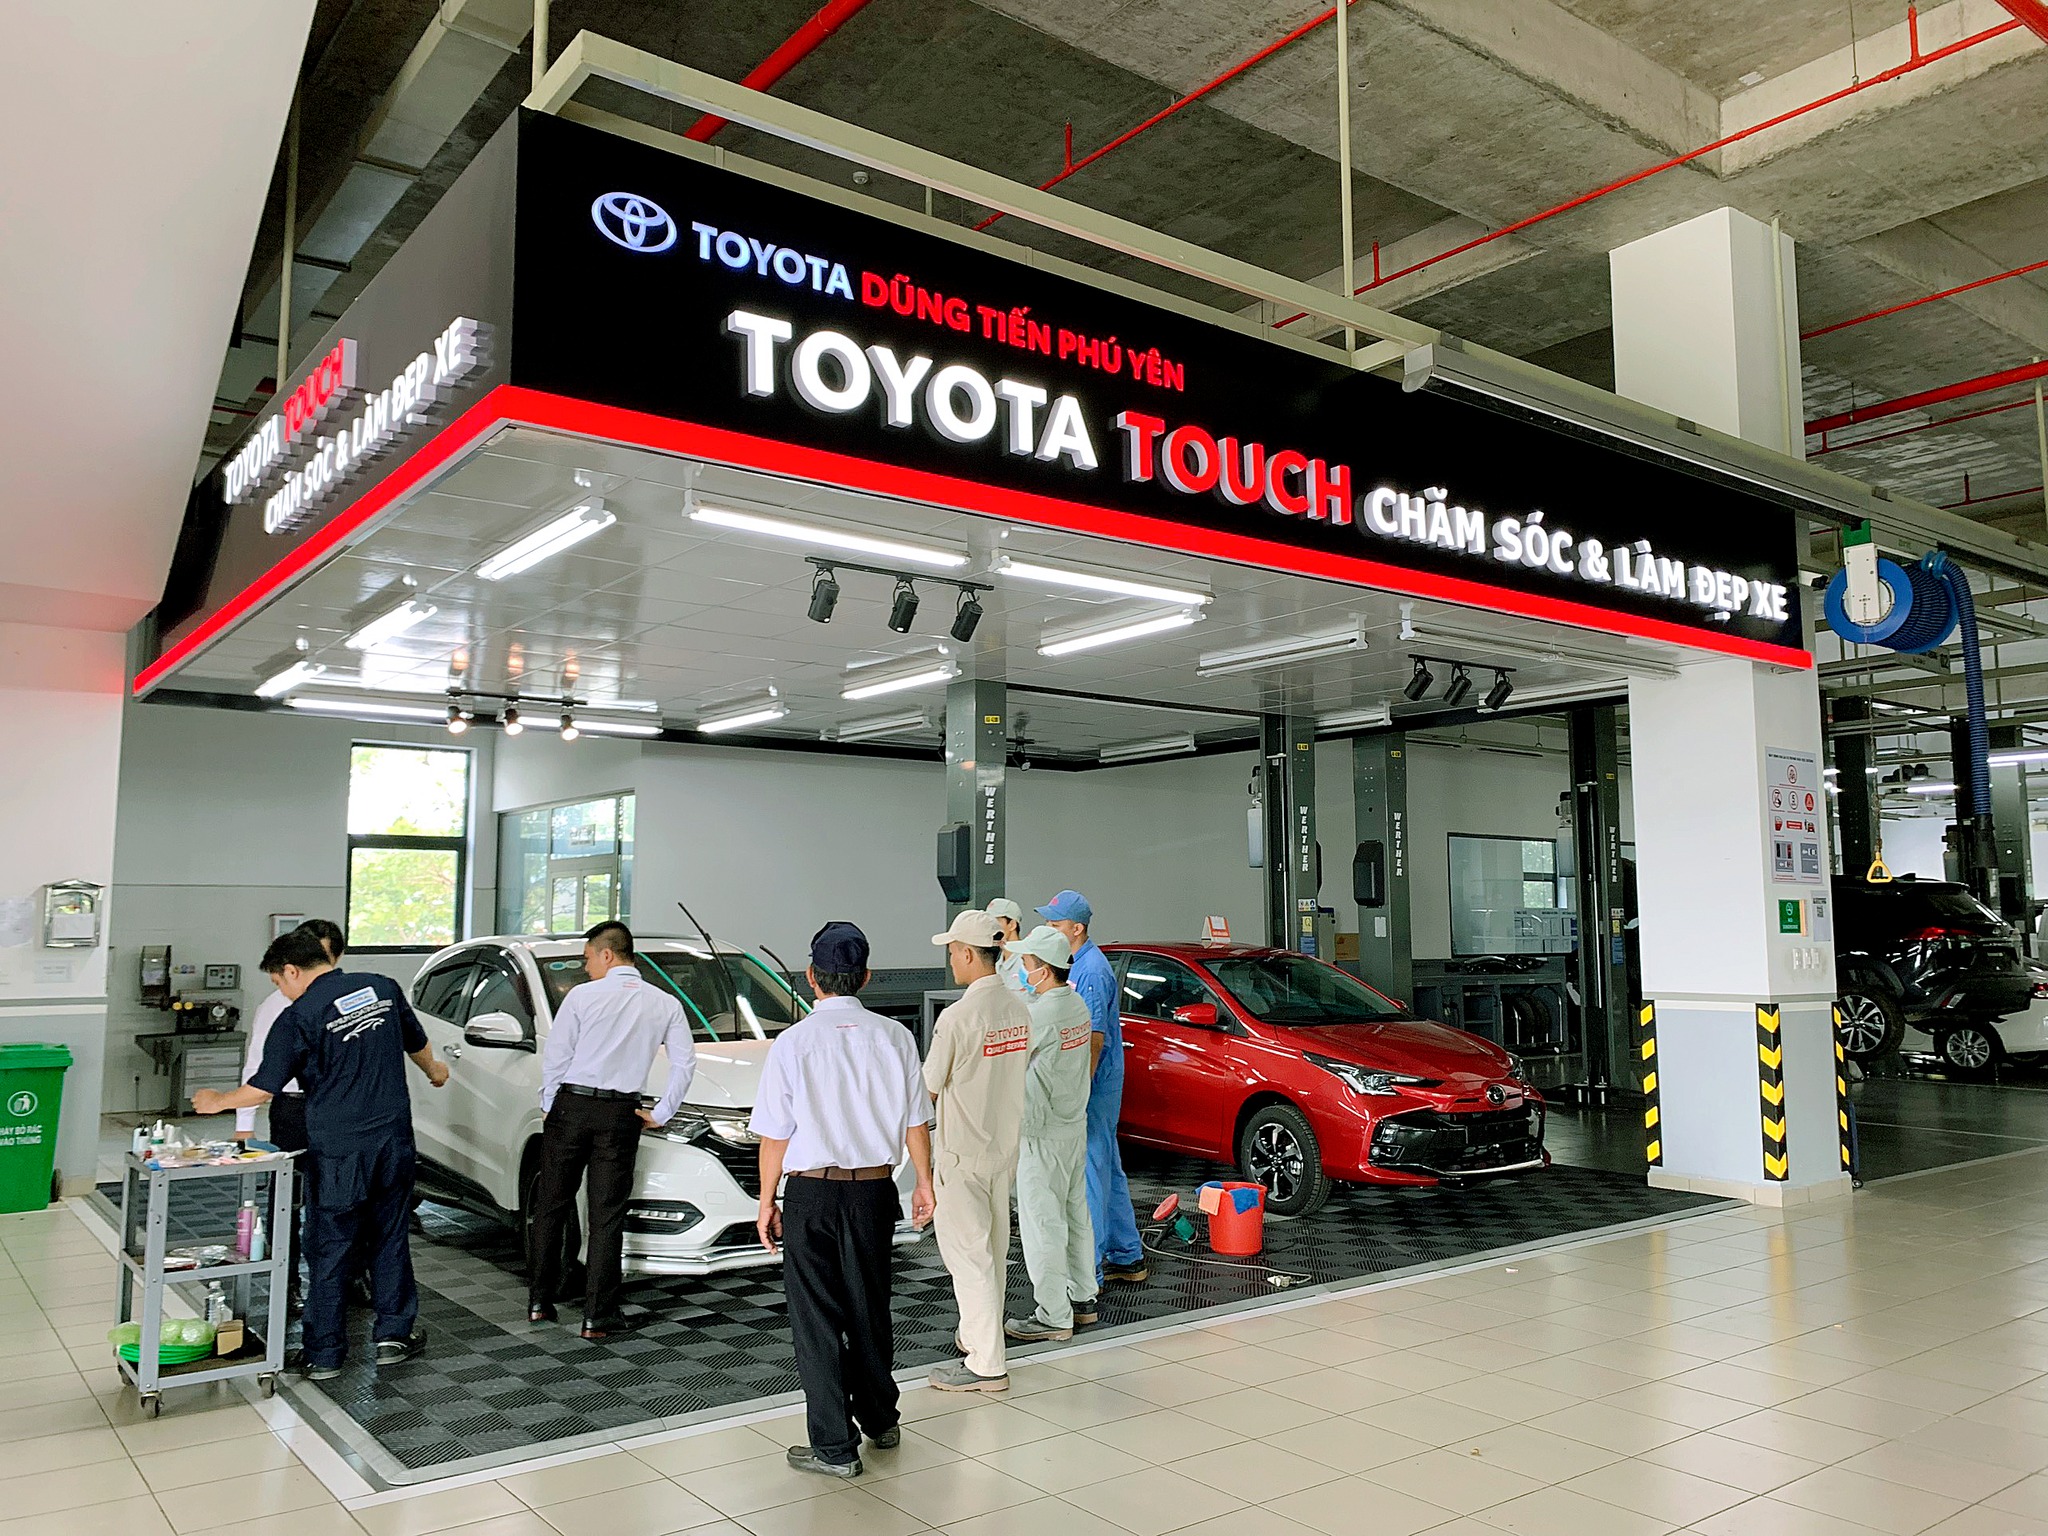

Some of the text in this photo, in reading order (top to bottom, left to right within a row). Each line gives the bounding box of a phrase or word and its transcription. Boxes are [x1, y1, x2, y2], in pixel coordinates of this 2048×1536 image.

[692, 220, 1185, 392] TOYOTA DŨNG TIẾN PHÚ YÊN
[224, 338, 357, 504] TOYOTA TOUCH
[264, 471, 304, 535] CHĂM
[303, 436, 341, 500] SÓC
[352, 393, 395, 458] LÀM
[392, 352, 436, 424] ĐẸP
[433, 316, 477, 384] XE
[727, 310, 1788, 623] TOYOTA TOUCH CHĂM SÓC & LÀM ĐẸP XE
[984, 786, 997, 865] WERTHER
[1299, 805, 1310, 872] WERTHER
[1393, 812, 1403, 877] WERTHER
